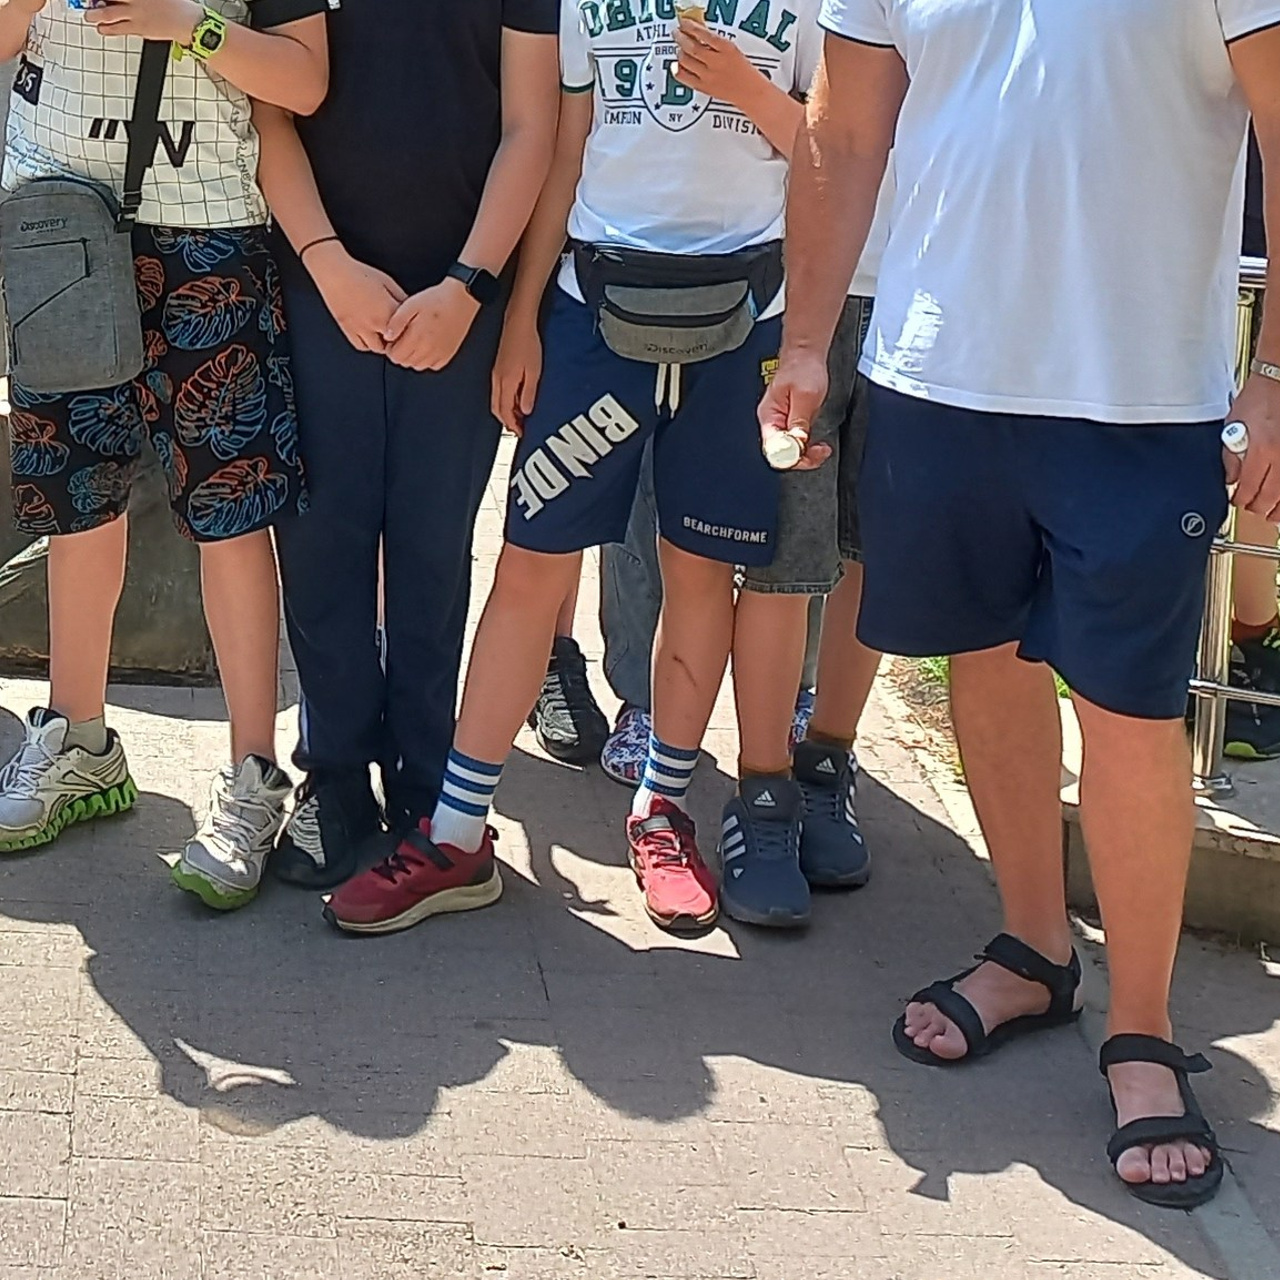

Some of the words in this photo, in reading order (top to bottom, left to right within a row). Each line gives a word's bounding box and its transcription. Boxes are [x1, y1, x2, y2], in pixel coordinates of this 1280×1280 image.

[636, 24, 670, 42] ATHL
[669, 113, 683, 123] NY
[20, 218, 68, 232] Discovery
